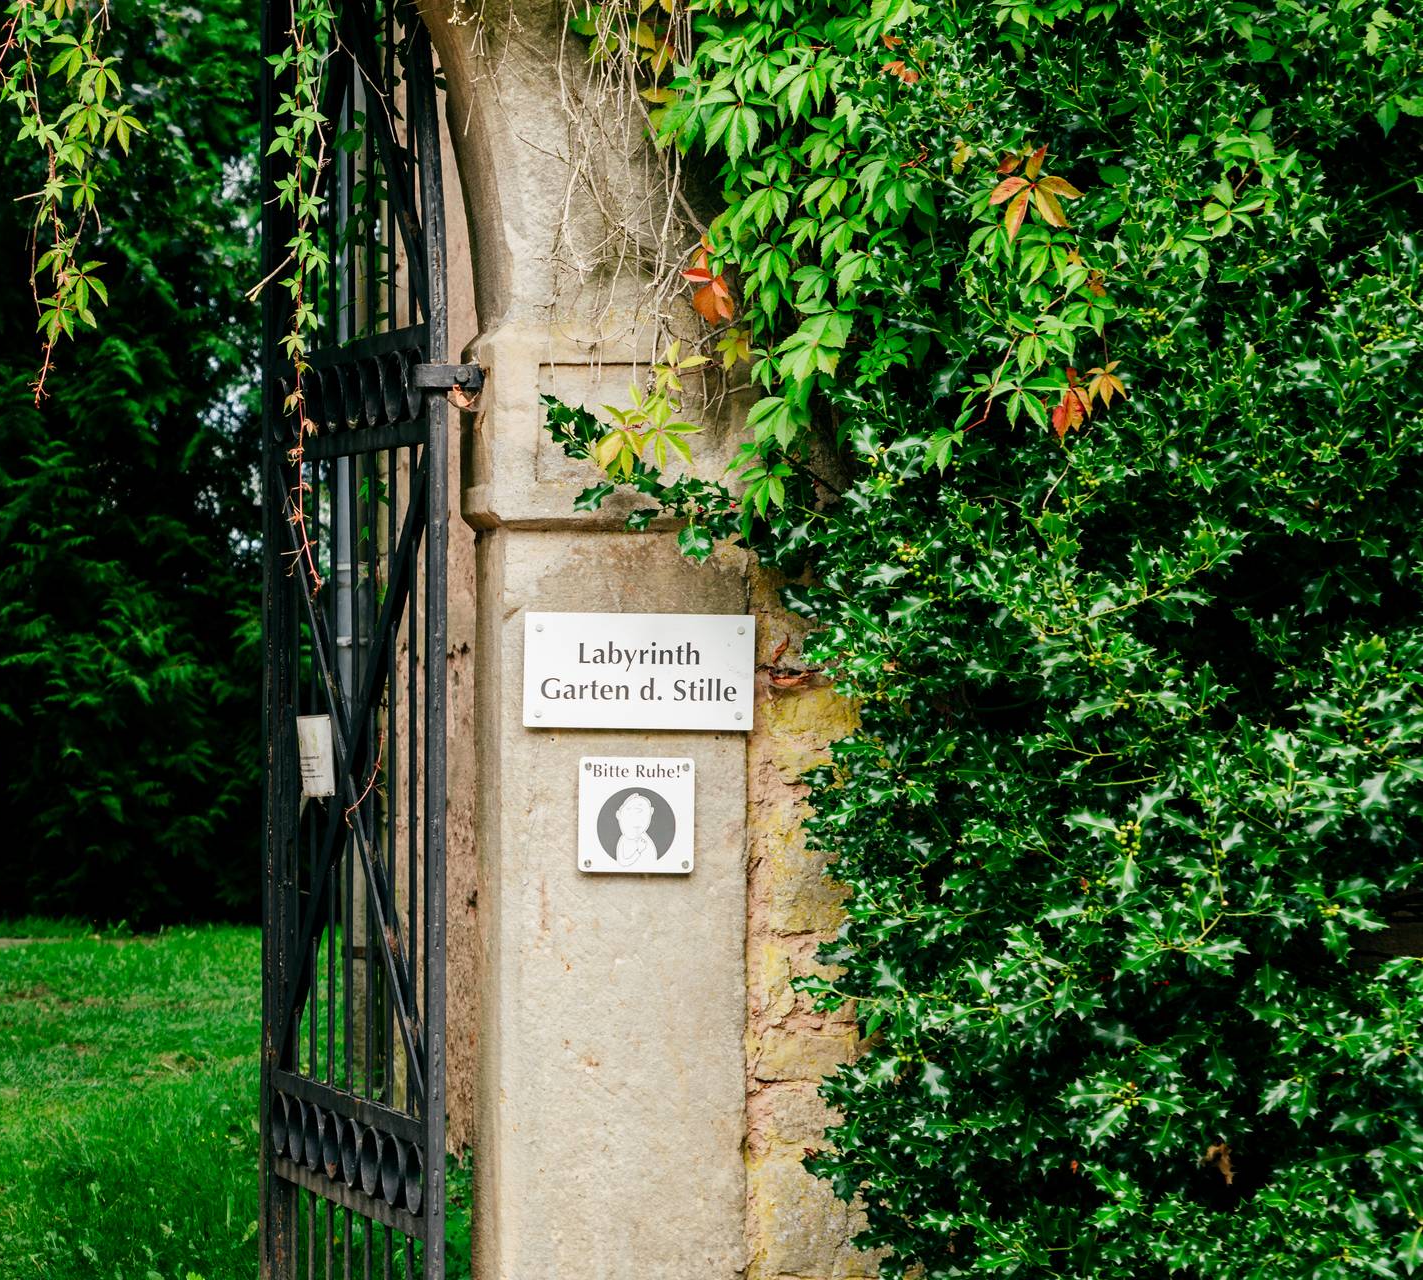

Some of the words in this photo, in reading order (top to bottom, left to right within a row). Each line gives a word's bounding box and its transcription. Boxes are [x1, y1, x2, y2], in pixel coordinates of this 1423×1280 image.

[578, 641, 700, 672] Labyrinth
[540, 677, 630, 700] Garten
[640, 677, 663, 701] d.
[673, 678, 737, 702] Stille
[593, 763, 629, 778] Bitte
[635, 763, 681, 779] Ruhe!
